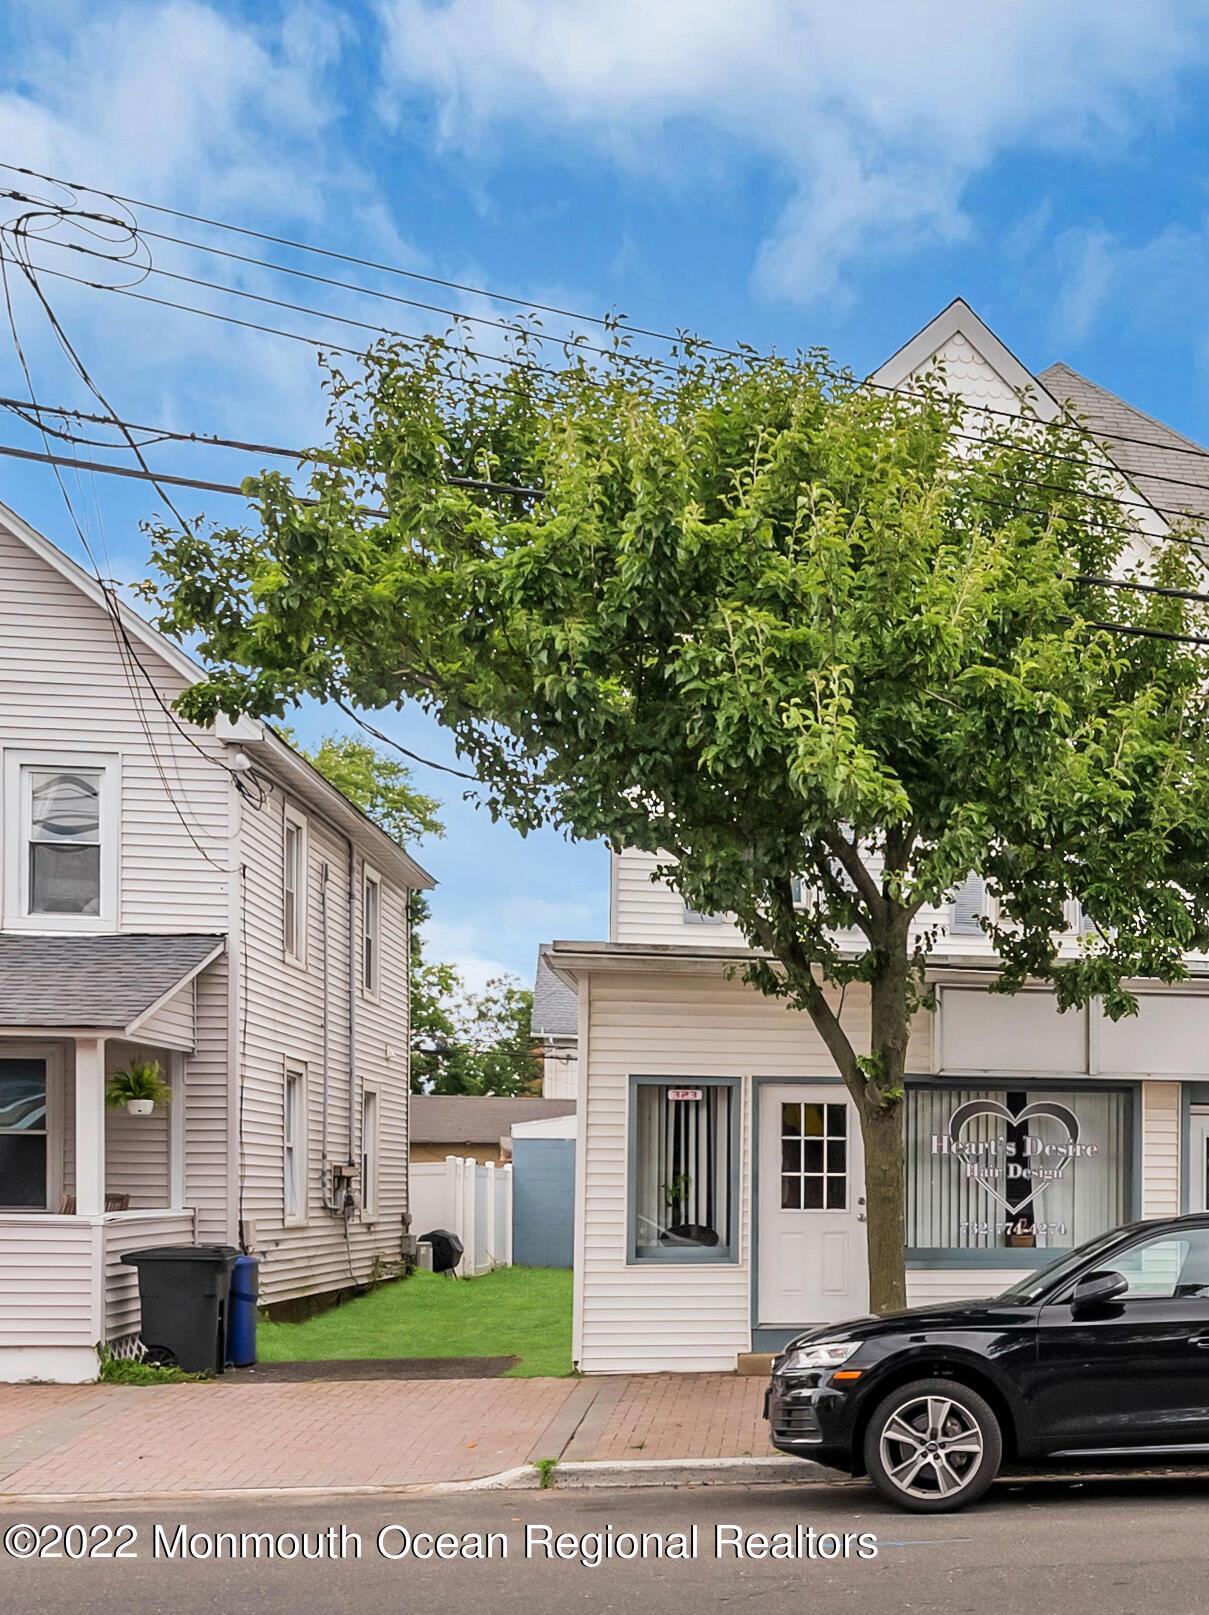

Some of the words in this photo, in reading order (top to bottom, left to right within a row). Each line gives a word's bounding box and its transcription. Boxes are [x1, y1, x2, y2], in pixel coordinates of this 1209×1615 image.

[930, 1135, 1017, 1157] Heart's
[1022, 1135, 1099, 1158] Desire
[966, 1163, 1003, 1179] Hair
[1007, 1163, 1064, 1180] Design
